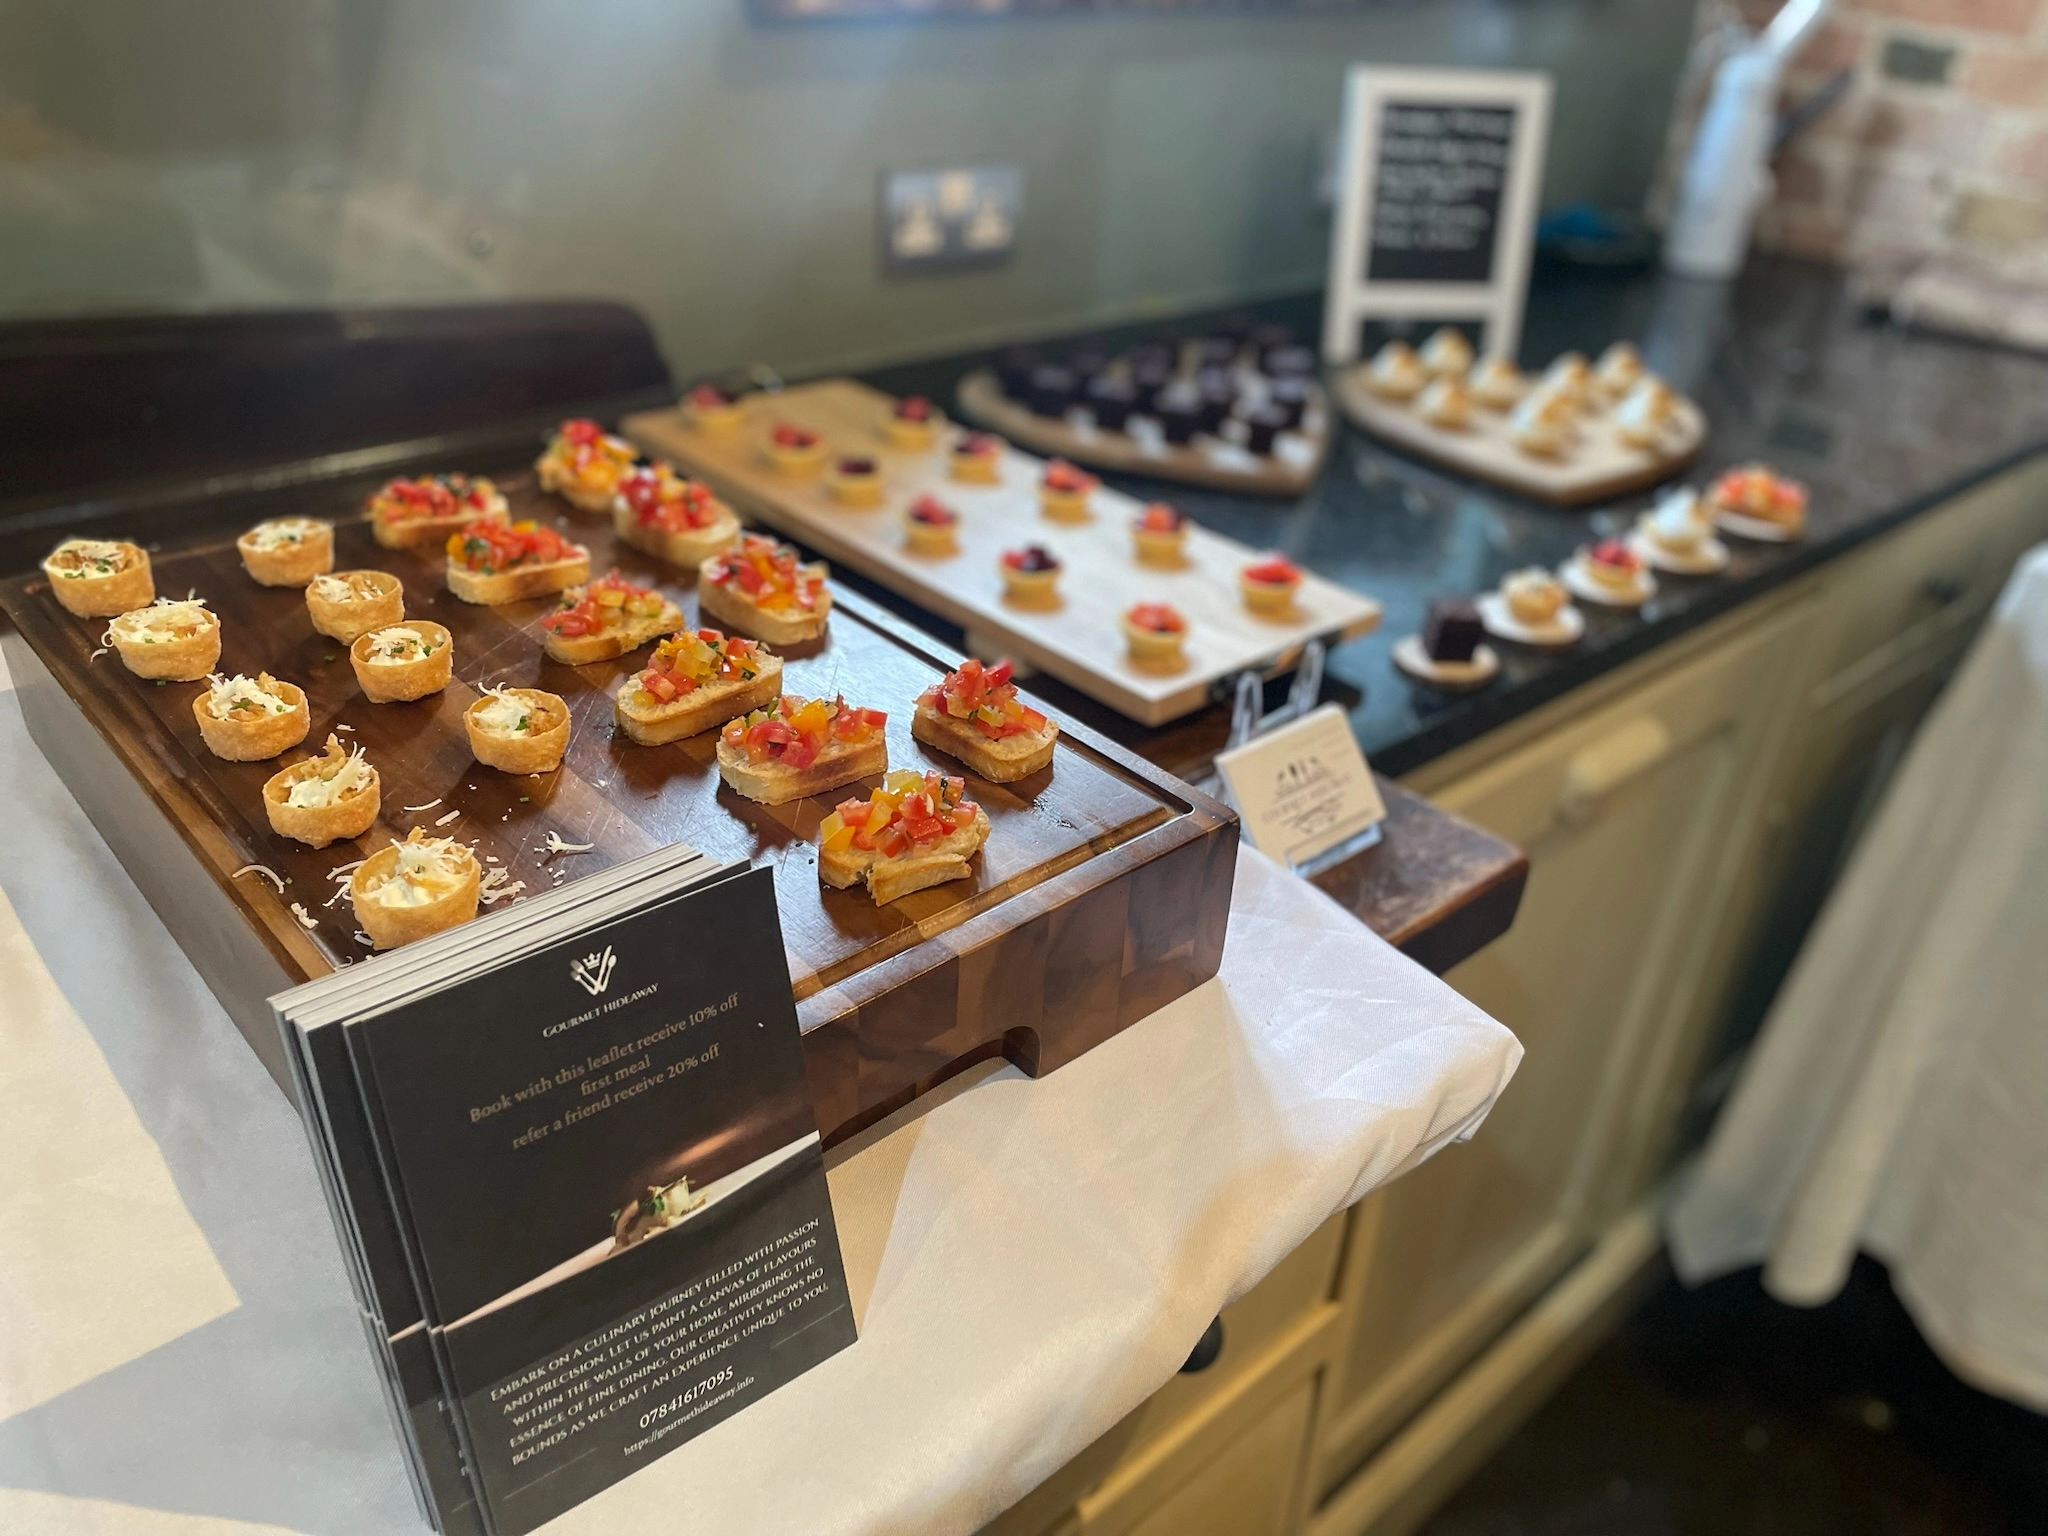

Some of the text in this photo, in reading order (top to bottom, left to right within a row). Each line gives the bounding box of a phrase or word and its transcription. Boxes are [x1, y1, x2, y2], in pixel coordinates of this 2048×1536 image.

[468, 990, 738, 1123] Book with this leaflet receive 10% off
[511, 1041, 720, 1149] refer a friend receive 20% off
[579, 1052, 651, 1096] first meal
[489, 1217, 819, 1401] EMBARK ON A CULINARY JOURNEY FILLED WITH PASSION
[502, 1390, 534, 1414] AND
[608, 1337, 631, 1358] LET
[632, 1329, 650, 1344] US
[650, 1308, 685, 1335] PAINT
[688, 1303, 698, 1315] A
[698, 1276, 745, 1308] CANVAS
[745, 1267, 760, 1282] OF
[762, 1236, 817, 1273] FLAVOURS
[509, 1412, 565, 1448] ESSENCE
[566, 1400, 583, 1416] OF
[587, 1384, 617, 1406] FINE
[669, 1338, 697, 1360] OUR
[697, 1300, 763, 1344] CREATIVITY
[765, 1277, 805, 1307] KNOWS
[805, 1266, 824, 1283] NO
[511, 1393, 563, 1426] WITHIN
[566, 1378, 591, 1398] THE
[592, 1357, 633, 1383] WALLS
[633, 1346, 650, 1362] OF
[652, 1326, 687, 1351] YOUR
[727, 1268, 792, 1310] MIRRORING
[792, 1254, 815, 1273] THE
[511, 1429, 568, 1465] BOUNDS
[569, 1419, 586, 1435] AS
[586, 1406, 607, 1423] WE
[608, 1383, 647, 1412] CRAFT
[650, 1371, 670, 1390] AN
[671, 1332, 740, 1377] EXPERIENCE
[741, 1307, 785, 1337] UNIQUE
[787, 1296, 801, 1311] TO
[623, 1375, 754, 1455] https://gourmethideaway.info
[638, 1365, 733, 1428] 07841617095
